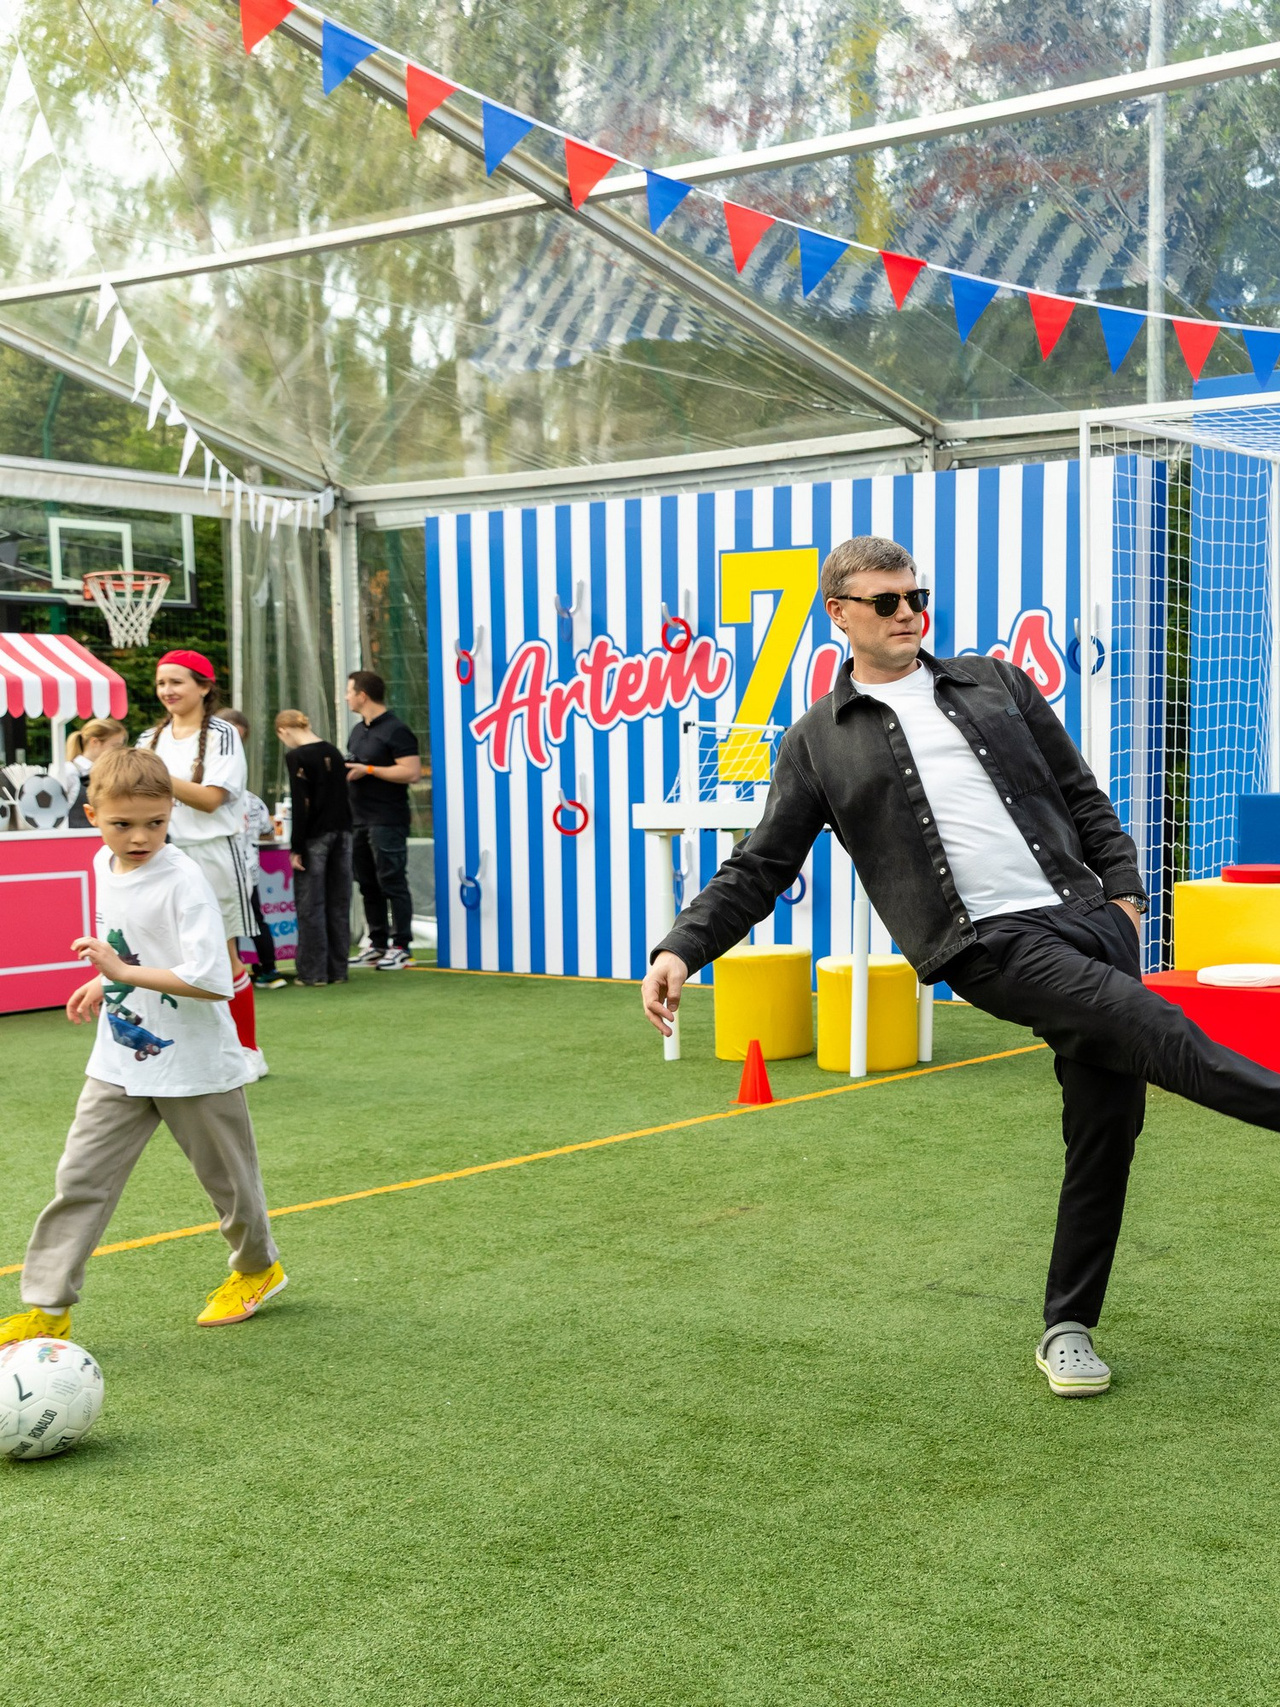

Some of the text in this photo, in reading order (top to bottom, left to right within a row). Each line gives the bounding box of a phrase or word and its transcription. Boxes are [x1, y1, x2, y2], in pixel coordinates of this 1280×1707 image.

[470, 634, 729, 770] Artem
[718, 548, 819, 782] 7
[28, 1409, 58, 1439] RONALDO
